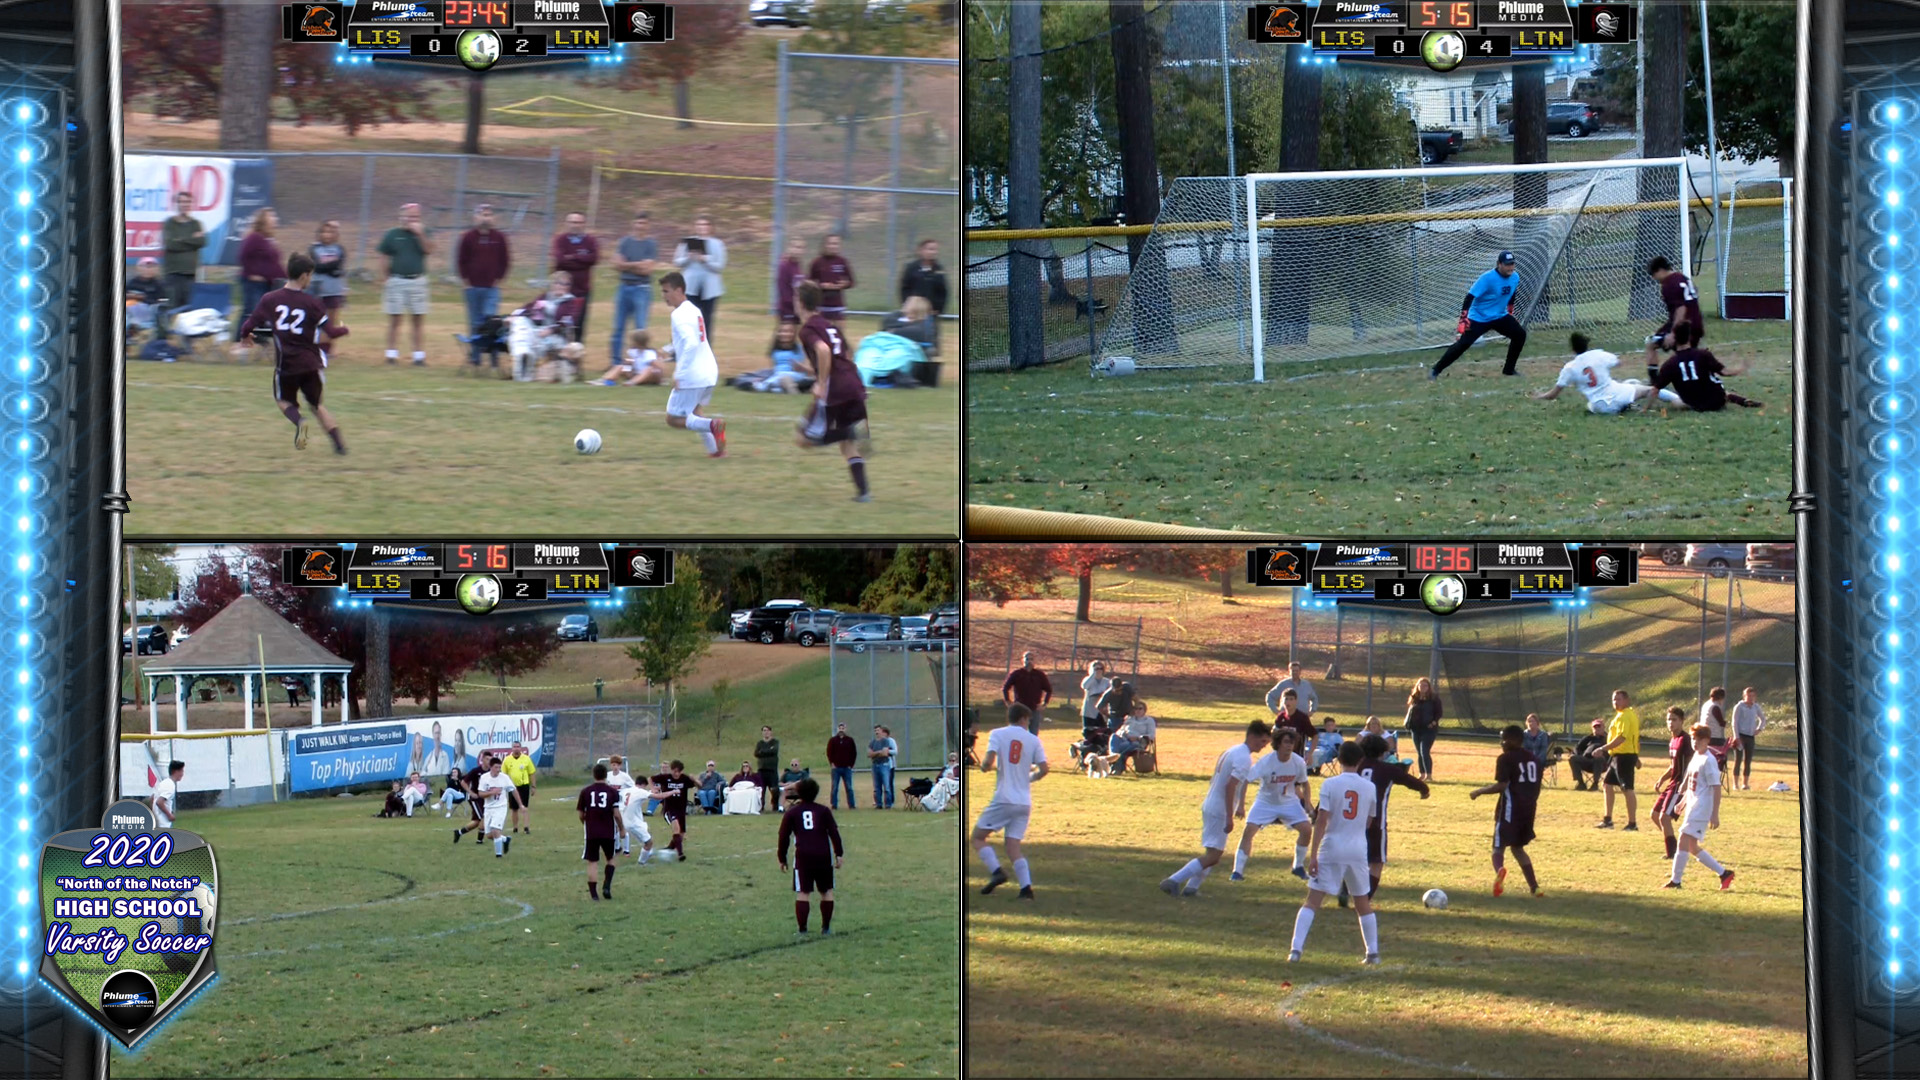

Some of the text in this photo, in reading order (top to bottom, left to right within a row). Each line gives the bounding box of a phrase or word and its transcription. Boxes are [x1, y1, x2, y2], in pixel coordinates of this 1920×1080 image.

[275, 305, 306, 335] 22
[826, 328, 842, 355] 5
[1583, 366, 1598, 388] 3
[1679, 360, 1699, 382] 11
[301, 737, 318, 749] JUST
[319, 735, 338, 747] WALK
[338, 733, 349, 745] IN!
[467, 717, 540, 746] ConvenientMD
[1008, 739, 1023, 765] 8
[310, 752, 398, 783] Top Physicians!
[1518, 760, 1537, 783] 10
[590, 791, 608, 808] 13
[1343, 789, 1359, 821] 3
[803, 810, 814, 830] 8
